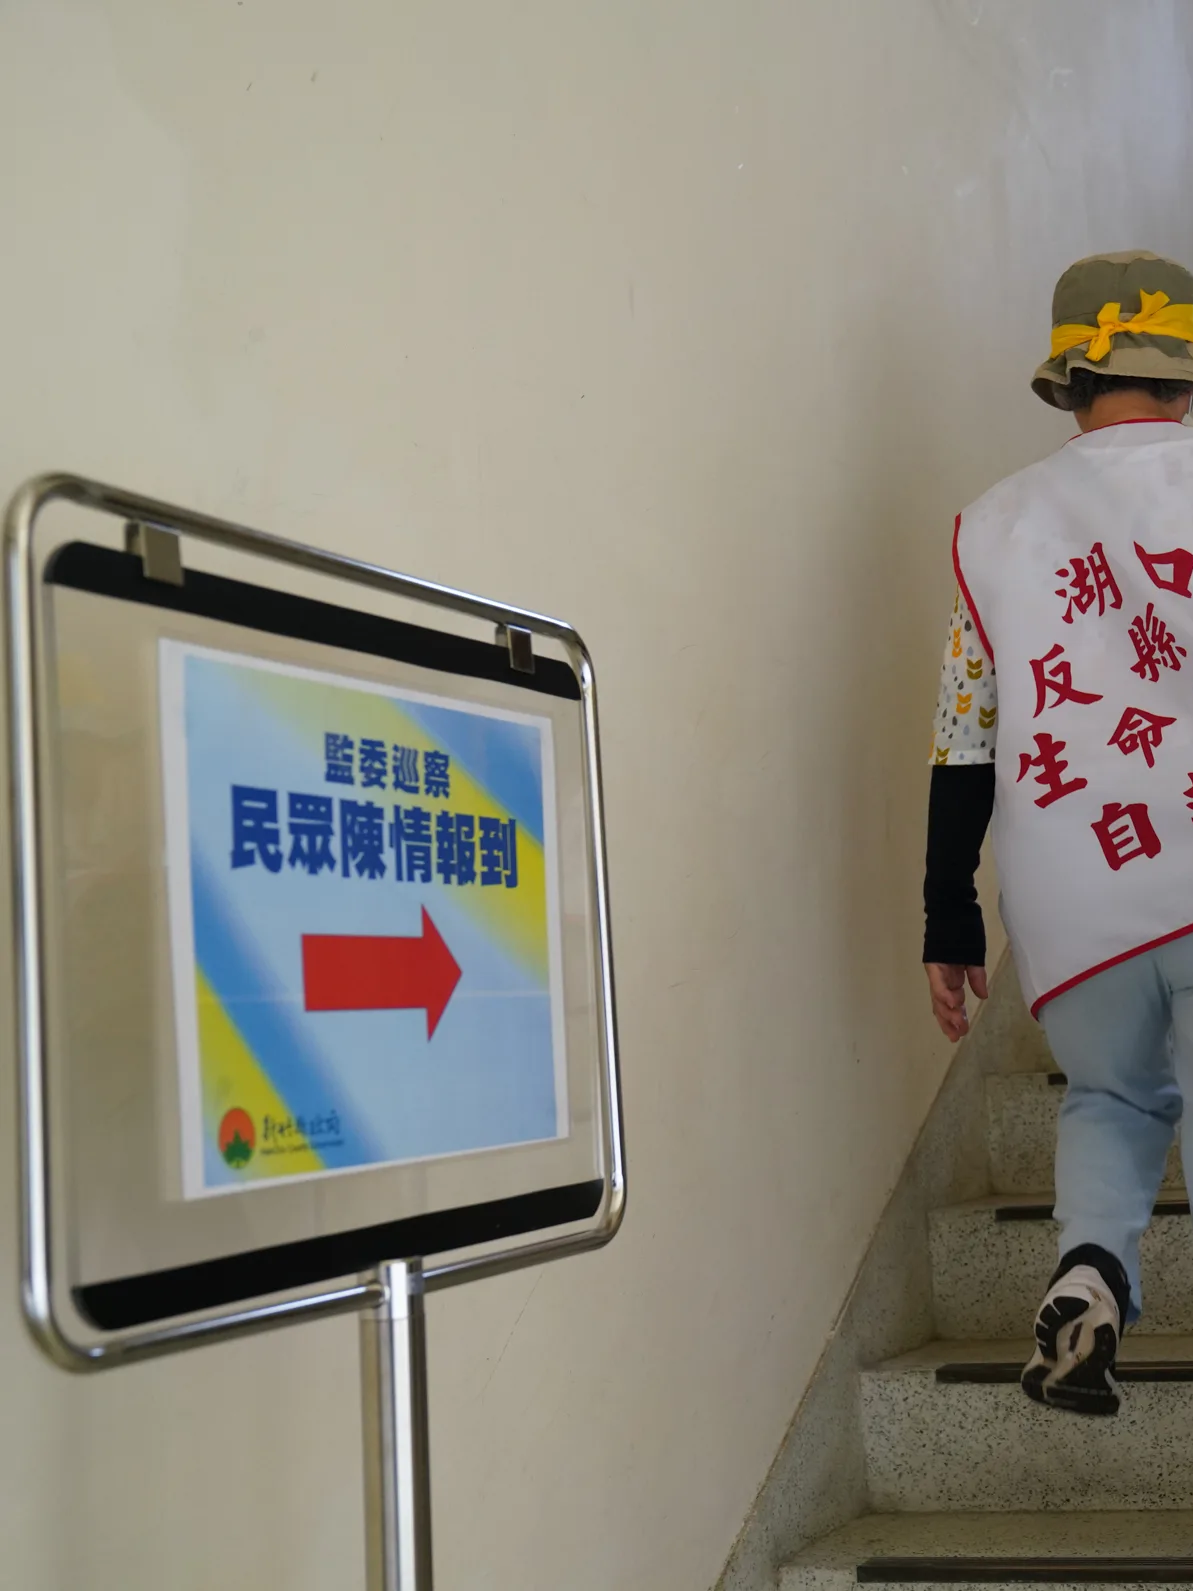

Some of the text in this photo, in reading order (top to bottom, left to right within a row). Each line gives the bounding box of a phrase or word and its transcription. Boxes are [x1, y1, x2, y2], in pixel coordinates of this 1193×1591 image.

[323, 731, 451, 799] 監委巡察
[229, 783, 519, 890] 民眾陳情報到
